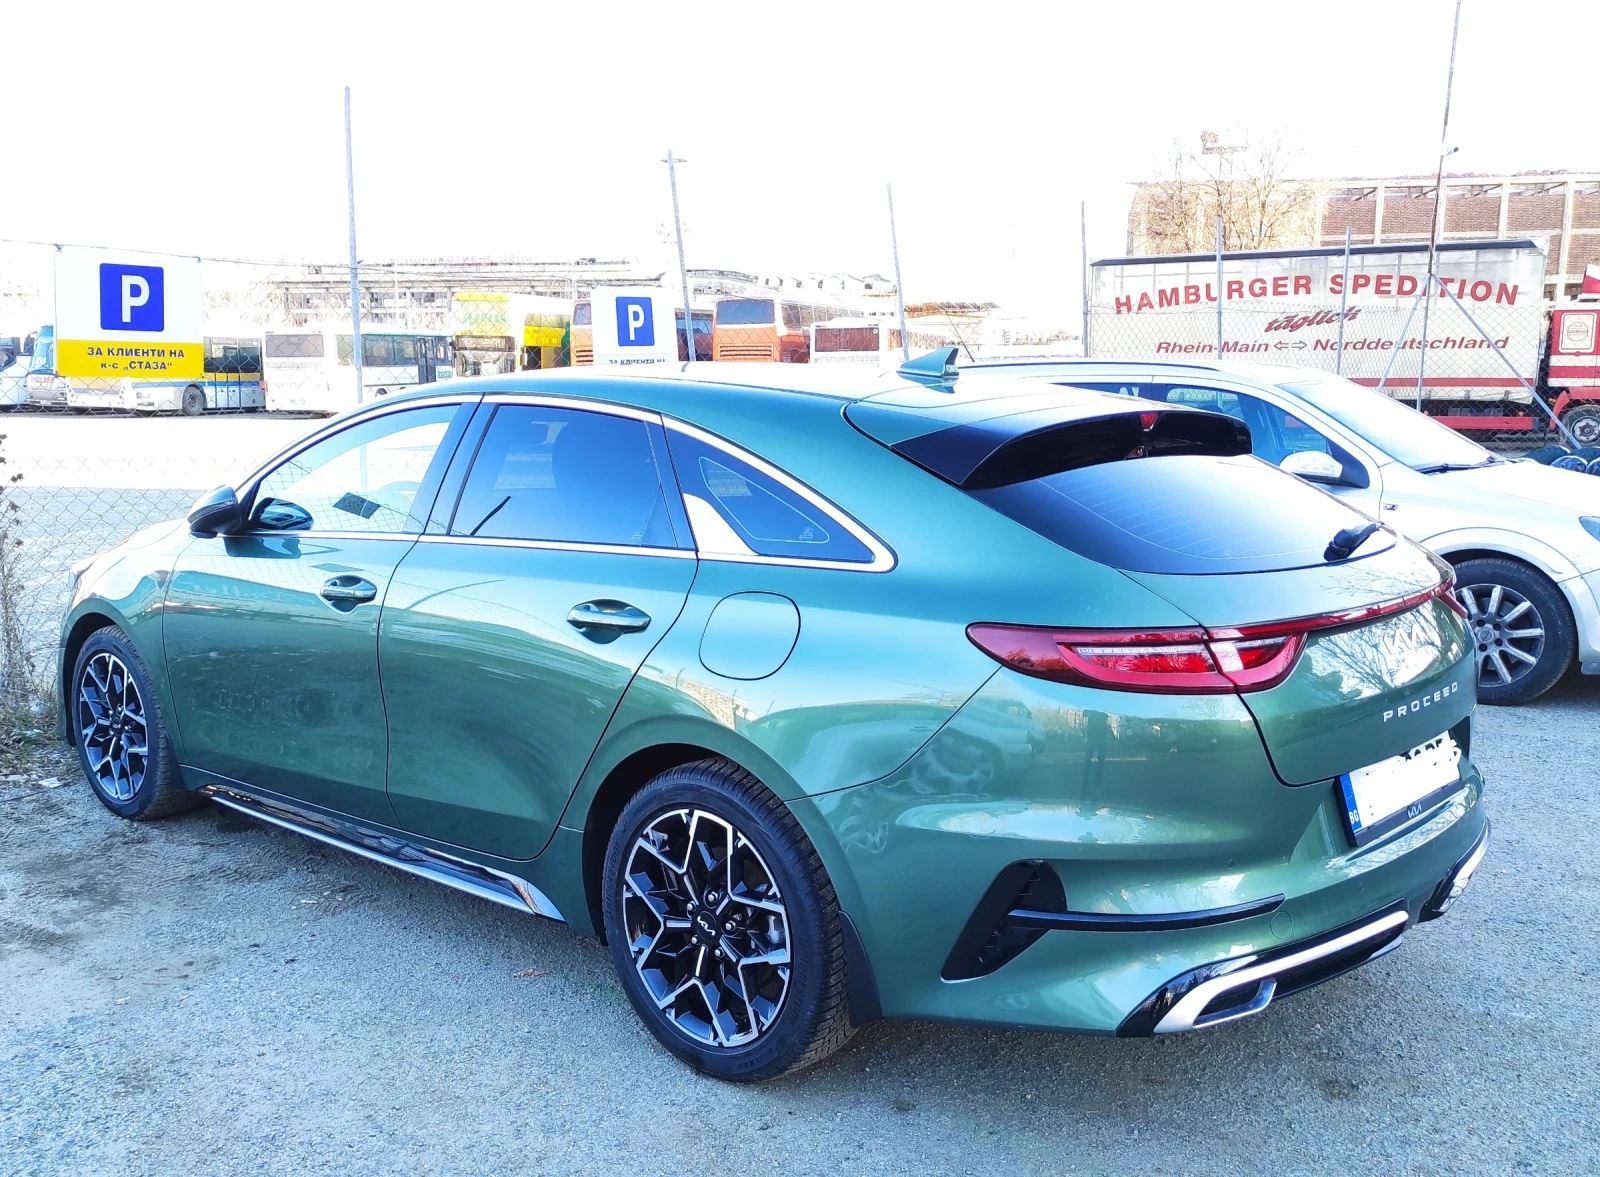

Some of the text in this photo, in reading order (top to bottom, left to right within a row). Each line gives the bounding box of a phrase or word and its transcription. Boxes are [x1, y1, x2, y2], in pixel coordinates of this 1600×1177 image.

[121, 274, 150, 323] P
[1115, 275, 1312, 315] HAMBURGER
[627, 304, 645, 341] P
[87, 347, 185, 358] ЗА КЛИЕНТИ НА
[1156, 340, 1269, 354] Rhein-Main
[100, 361, 119, 369] к-с
[1383, 681, 1458, 723] PROCEED
[1349, 811, 1360, 826] BG
